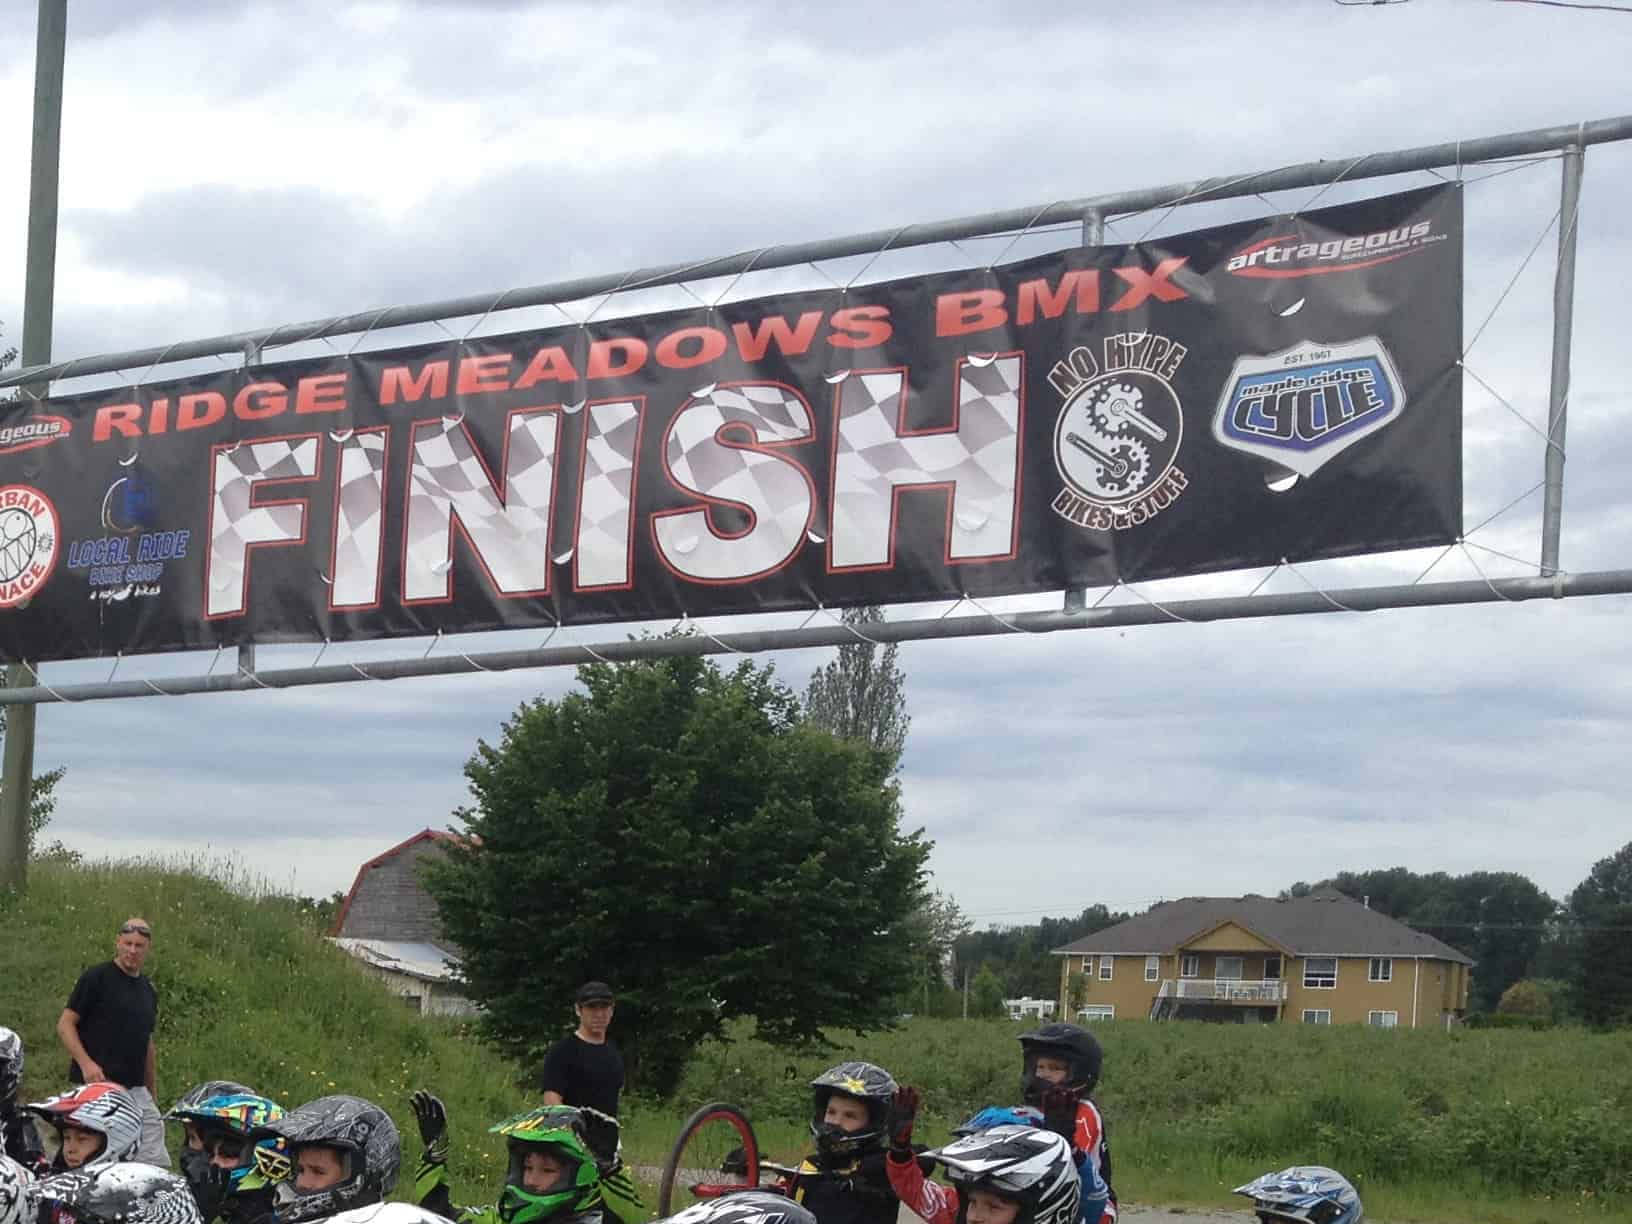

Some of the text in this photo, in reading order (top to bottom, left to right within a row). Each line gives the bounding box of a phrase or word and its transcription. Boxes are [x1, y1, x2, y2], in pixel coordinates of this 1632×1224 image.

[1227, 220, 1431, 271] artrageous
[93, 256, 1190, 441] RIDGE MEADOWS BMX
[1047, 331, 1188, 398] NO HYPE
[1233, 380, 1384, 441] CYCLE
[1239, 367, 1374, 397] maple ridge
[204, 350, 1025, 620] FINISH
[1051, 487, 1112, 530] BIKES
[1129, 466, 1189, 525] STUFF
[68, 529, 190, 569] LOCAL RIDE
